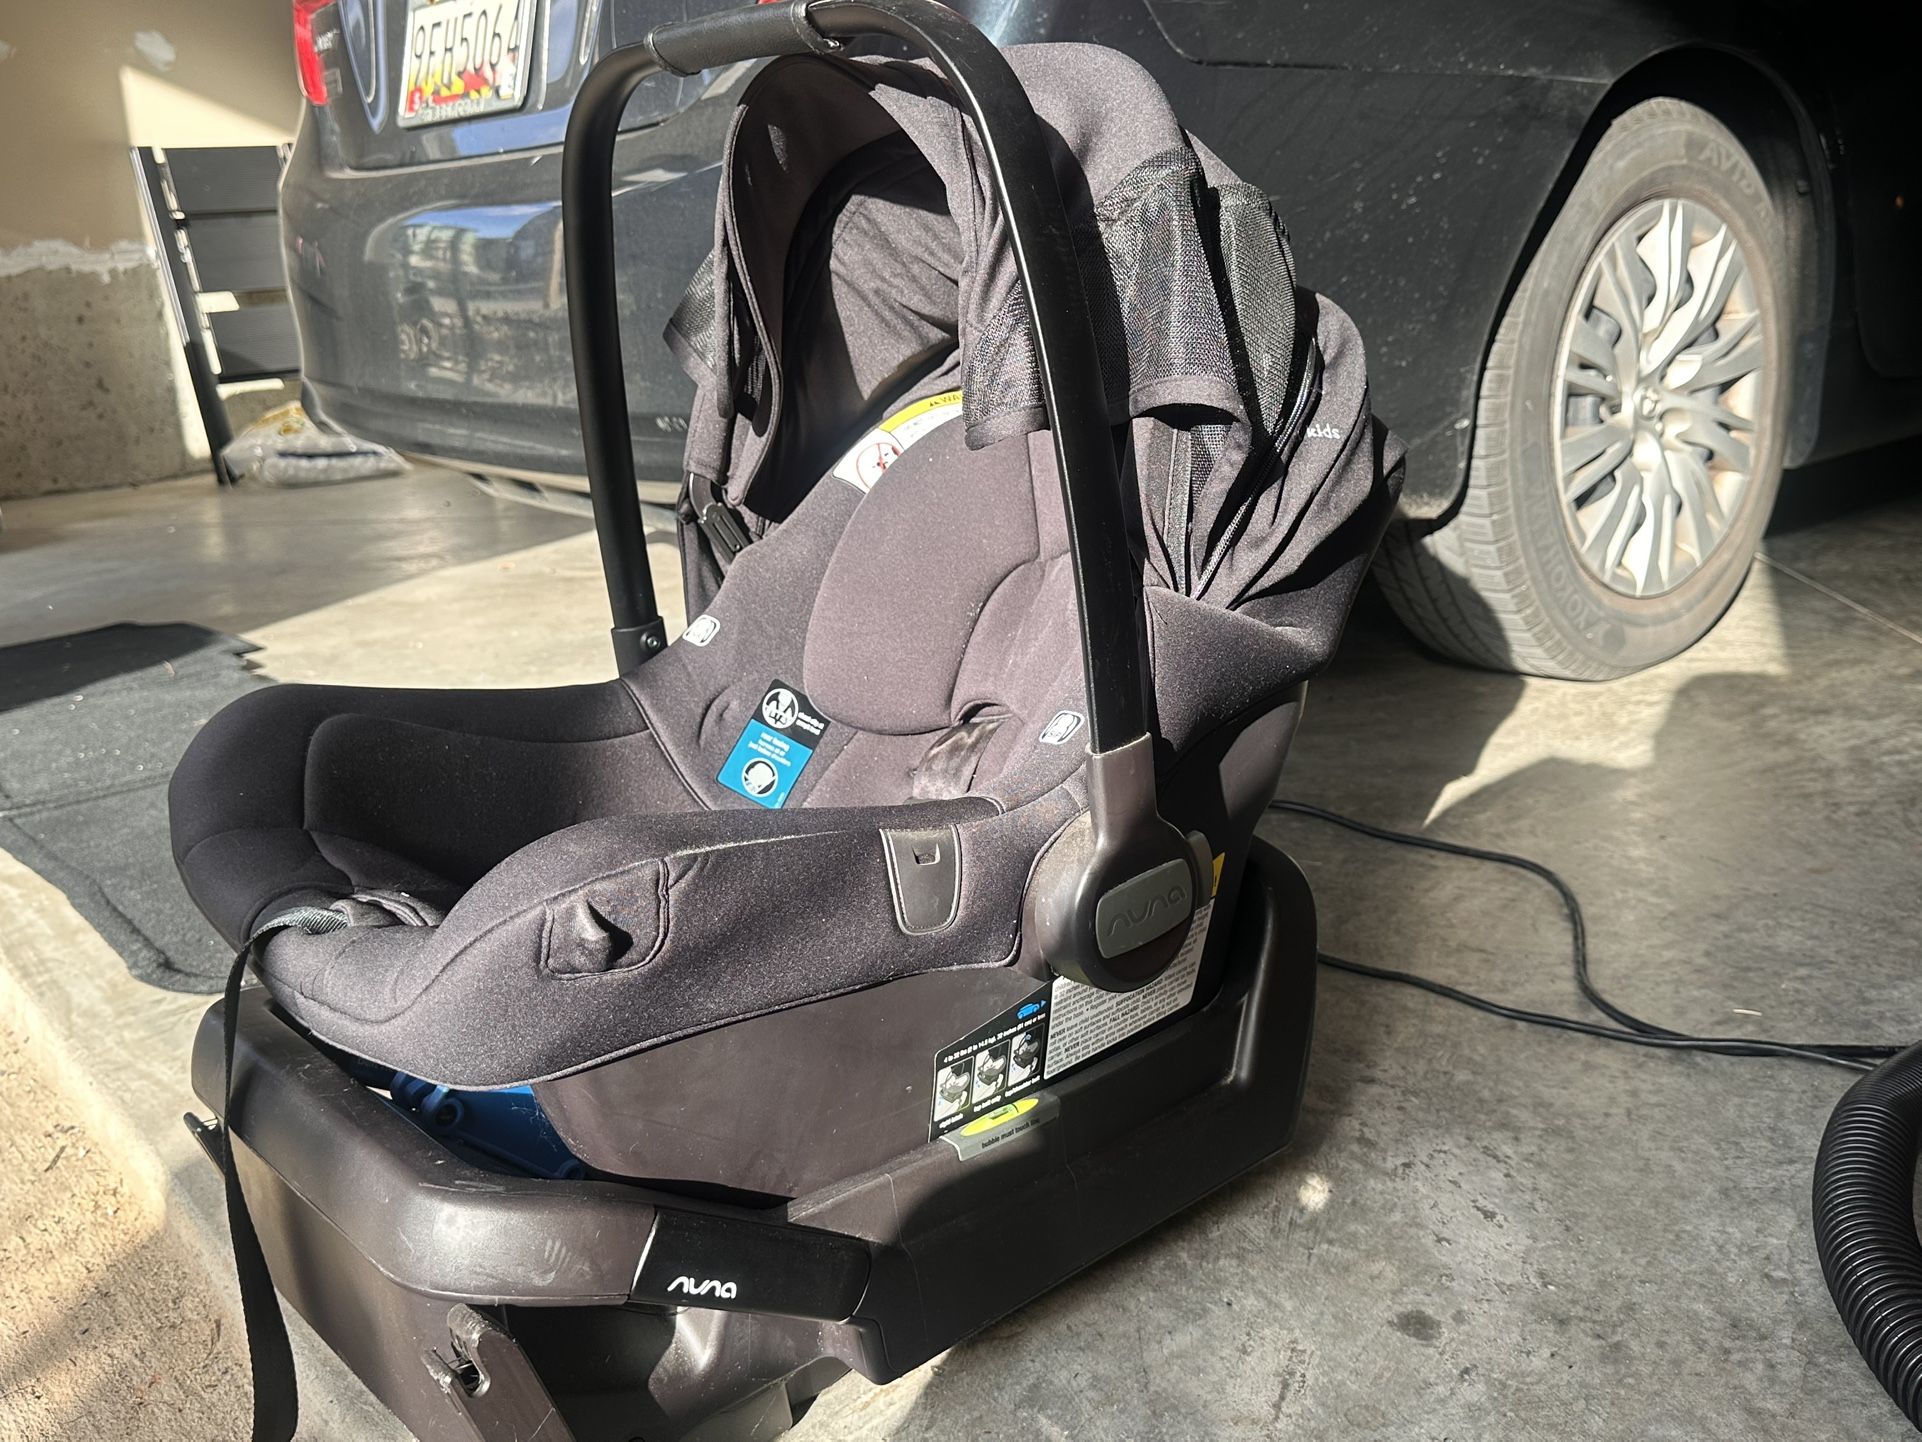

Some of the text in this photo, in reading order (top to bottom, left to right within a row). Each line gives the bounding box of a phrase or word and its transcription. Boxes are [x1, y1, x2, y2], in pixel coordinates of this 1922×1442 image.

[1107, 885, 1187, 937] nuna
[981, 1134, 999, 1148] bubble
[1001, 1128, 1013, 1139] must
[667, 1276, 737, 1299] nuna
